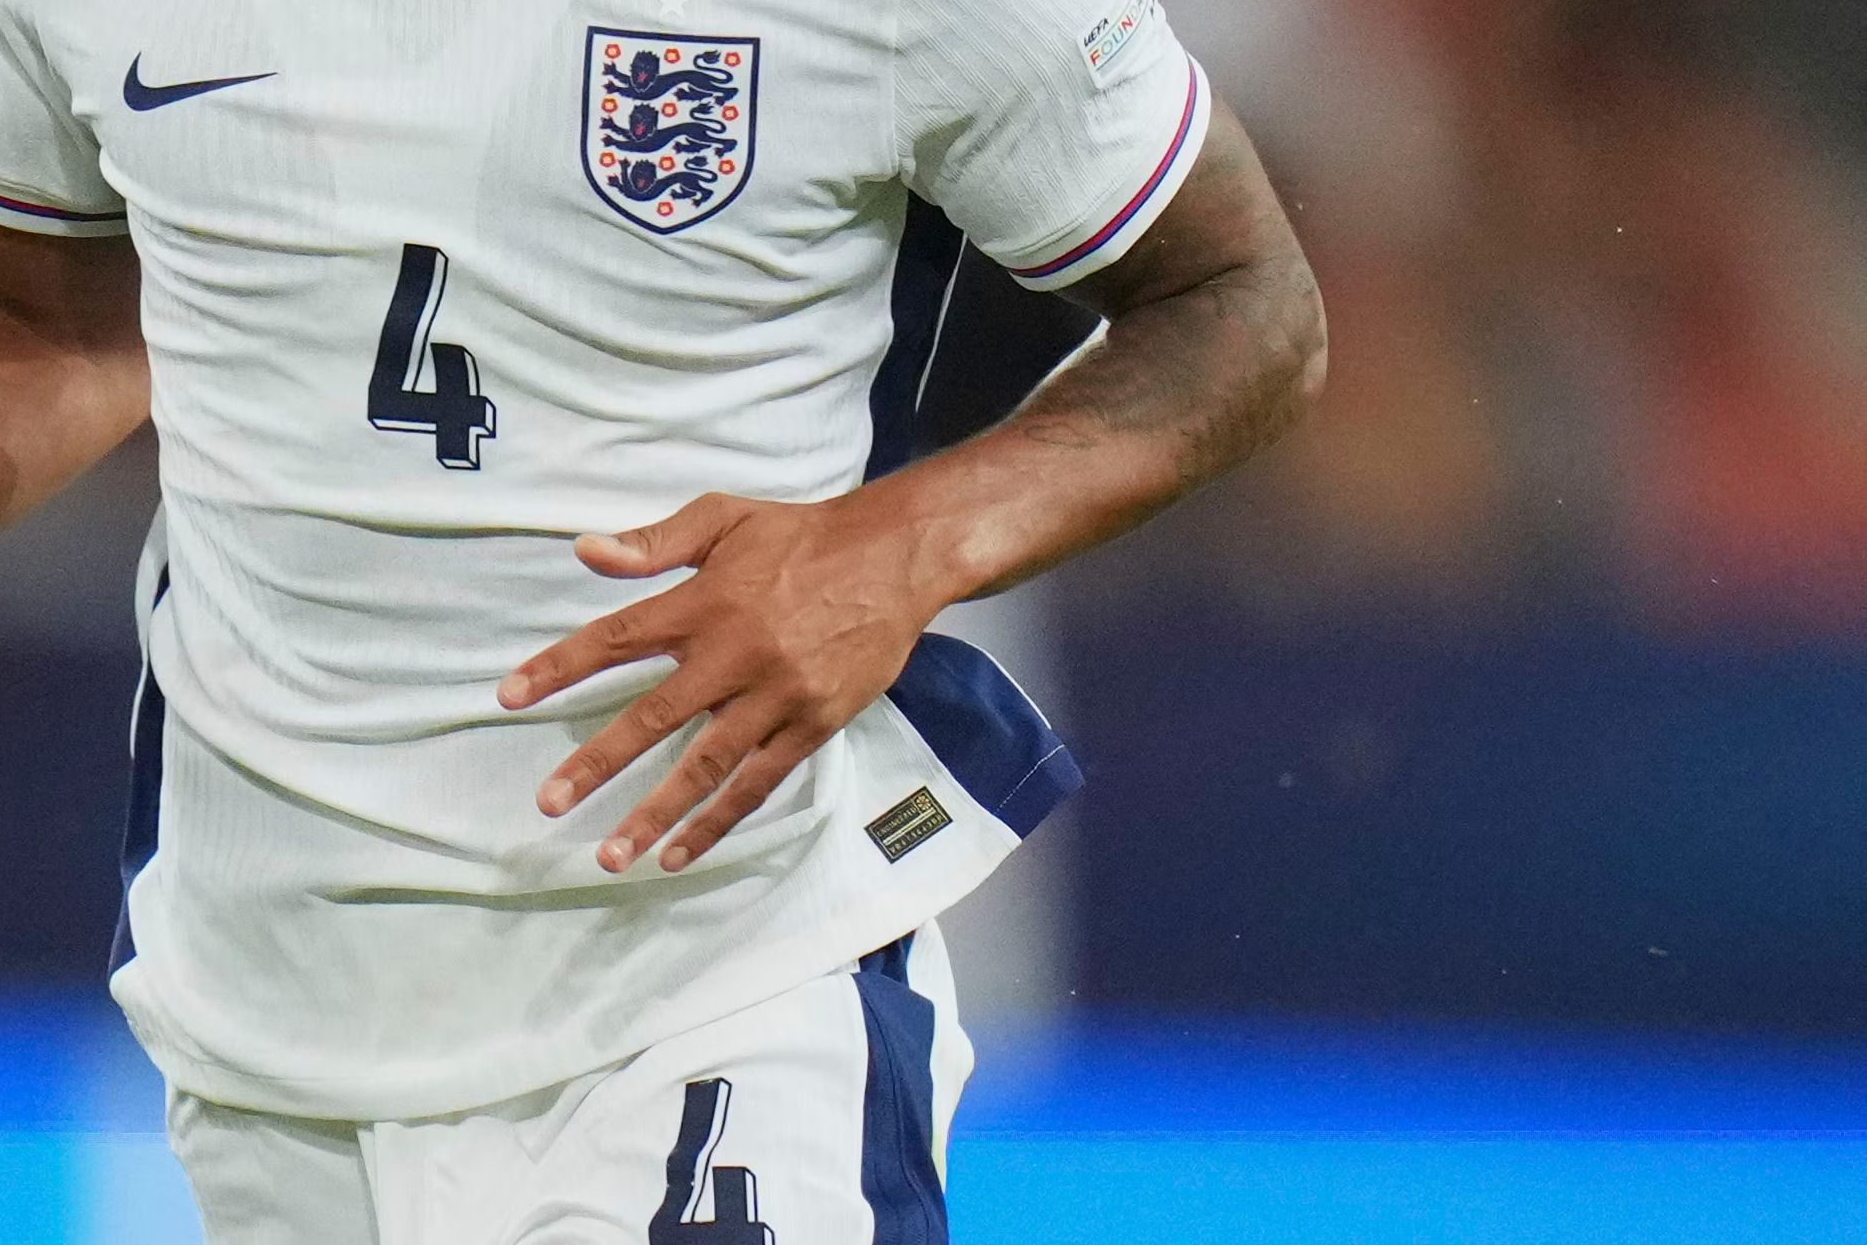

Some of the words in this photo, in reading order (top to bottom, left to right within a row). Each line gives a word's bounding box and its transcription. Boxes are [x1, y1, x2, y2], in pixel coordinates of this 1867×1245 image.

[1084, 17, 1109, 47] UEFA
[367, 243, 495, 471] 4
[648, 1078, 776, 1245] 4
